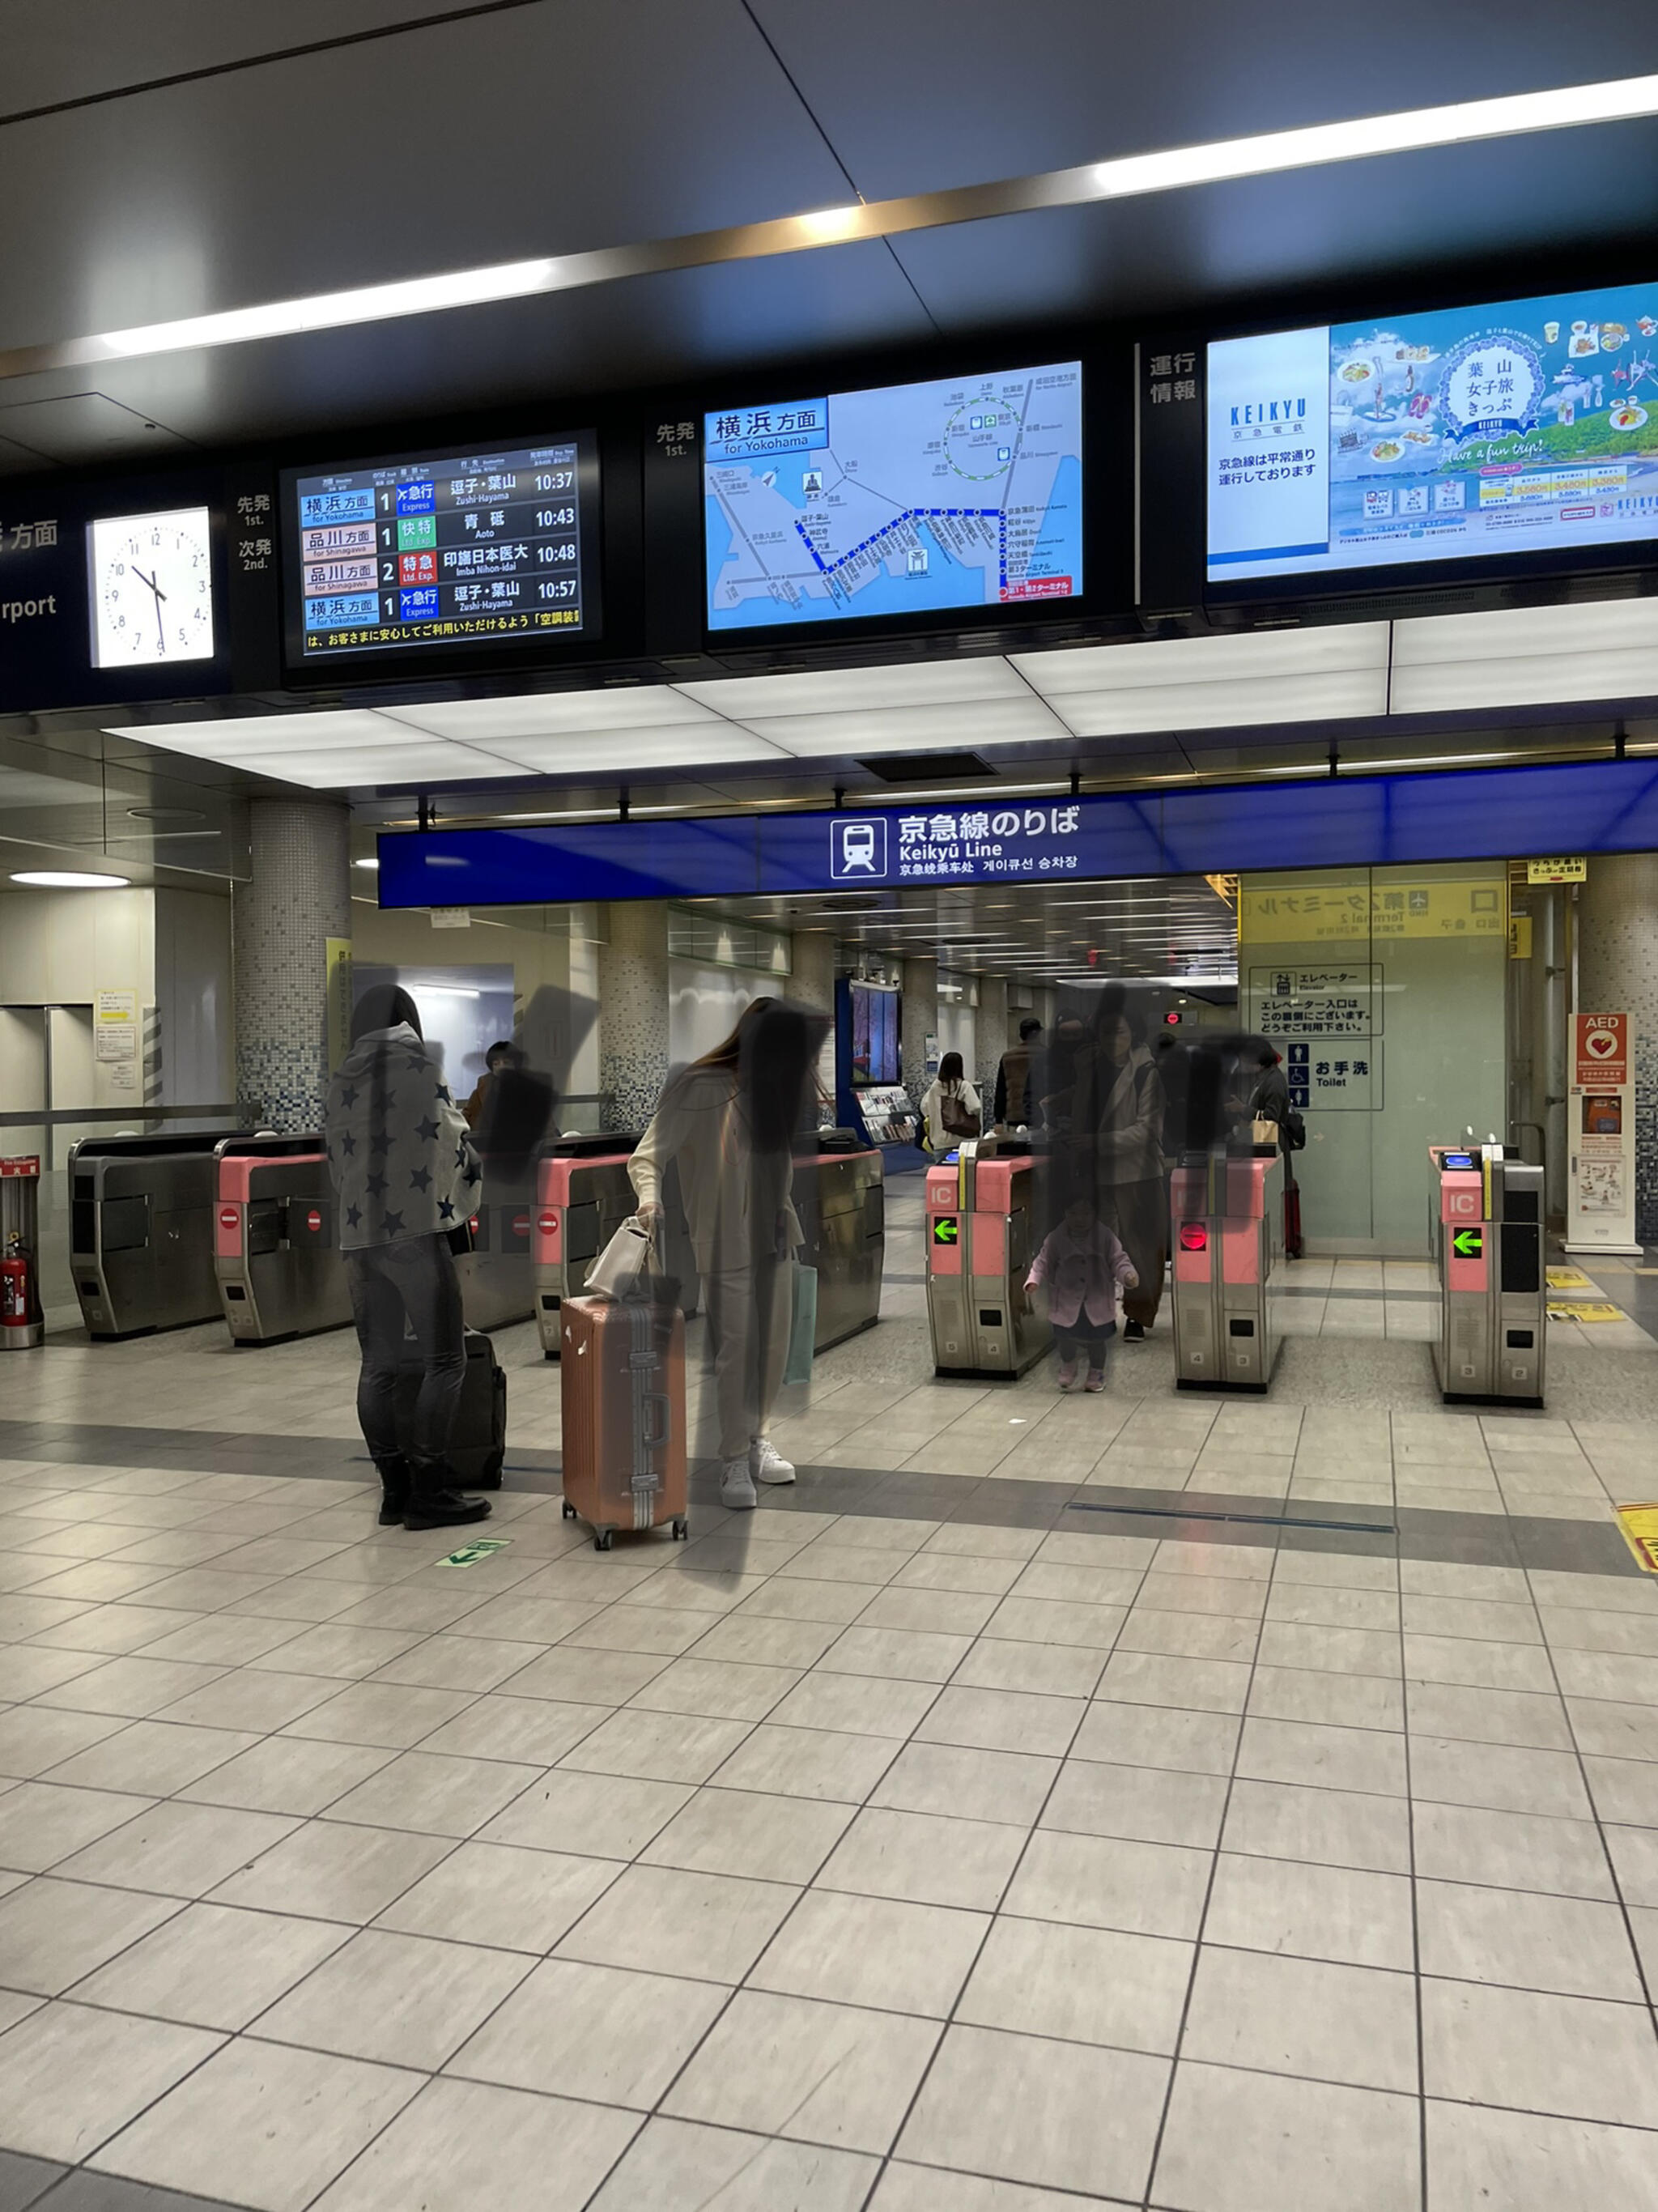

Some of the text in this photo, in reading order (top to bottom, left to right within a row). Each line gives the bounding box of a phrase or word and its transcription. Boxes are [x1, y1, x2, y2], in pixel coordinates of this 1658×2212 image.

[1150, 352, 1196, 376] 運行
[1468, 359, 1512, 378] 葉山
[1150, 380, 1196, 403] 情報
[1466, 378, 1514, 398] 女子旅
[1231, 398, 1305, 426] KEIKYU
[1469, 398, 1512, 416] きっぷ
[657, 422, 695, 443] 先発
[716, 410, 816, 438] 横浜方面
[1233, 423, 1303, 439] 京急電鉄
[665, 445, 687, 457] 1st.
[725, 436, 808, 454] for Yokohama
[1438, 439, 1543, 464] Have a fun trip!
[1219, 449, 1316, 470] 京急線は平常通り
[534, 472, 573, 491] 10:37
[1218, 464, 1316, 486] 運行しております
[450, 473, 517, 496] 逗子・葉山
[237, 494, 270, 514] 先発
[306, 495, 368, 513] 横浜方面
[380, 493, 389, 511] 1
[456, 492, 509, 505] Zushi-Hayama
[402, 502, 430, 513] Express
[244, 516, 264, 526] 1st.
[312, 512, 363, 523] for Yokohama
[465, 510, 504, 530] 青砥
[536, 508, 574, 526] 10:43
[0, 520, 57, 551] 方面
[402, 520, 432, 536] 快特
[475, 530, 495, 538] Aoto
[151, 534, 160, 546] 12
[176, 538, 180, 550] 1
[309, 530, 369, 547] 品川方面
[382, 528, 391, 546] 1
[130, 543, 138, 555] 11
[239, 538, 272, 557] 次発
[325, 547, 366, 556] Shinagawa
[538, 544, 576, 563] 10:48
[115, 564, 124, 576] 10
[192, 555, 198, 568] 2
[244, 559, 268, 570] 2nd.
[403, 555, 433, 572] 特急
[456, 562, 517, 576] Imba Nihon-idai
[311, 564, 371, 582] 品川方面
[383, 563, 394, 581] 2
[403, 573, 434, 582] Ltd. Exp.
[198, 581, 206, 593] 3
[326, 581, 368, 590] Shinagawa
[454, 581, 520, 602] 逗子・葉山
[538, 581, 576, 598] 10:57
[112, 590, 119, 602] 9
[2, 595, 56, 623] rport
[193, 608, 201, 619] 4
[310, 599, 372, 617] 横浜方面
[385, 598, 393, 615] 1
[406, 607, 434, 617] Express
[460, 599, 513, 611] Zushi-Hayama
[119, 616, 125, 627] 8
[329, 615, 368, 625] Yokohama
[135, 632, 142, 644] 7
[179, 628, 185, 640] 5
[157, 639, 164, 650] 6
[899, 806, 1081, 843] 京急線のりば
[899, 841, 1002, 861] Keikyū Line
[983, 857, 1033, 871] 게이큐선
[1038, 855, 1078, 870] 승차장
[1299, 973, 1358, 982] エレベーター
[1261, 999, 1358, 1010] エレベーター入口は
[1261, 1023, 1362, 1032] どうぞご利用下さい。
[1586, 1017, 1618, 1028] AED
[1316, 1061, 1368, 1075] お手洗
[1316, 1078, 1346, 1087] Toilet
[931, 1187, 951, 1204] IC
[1450, 1194, 1474, 1213] IC
